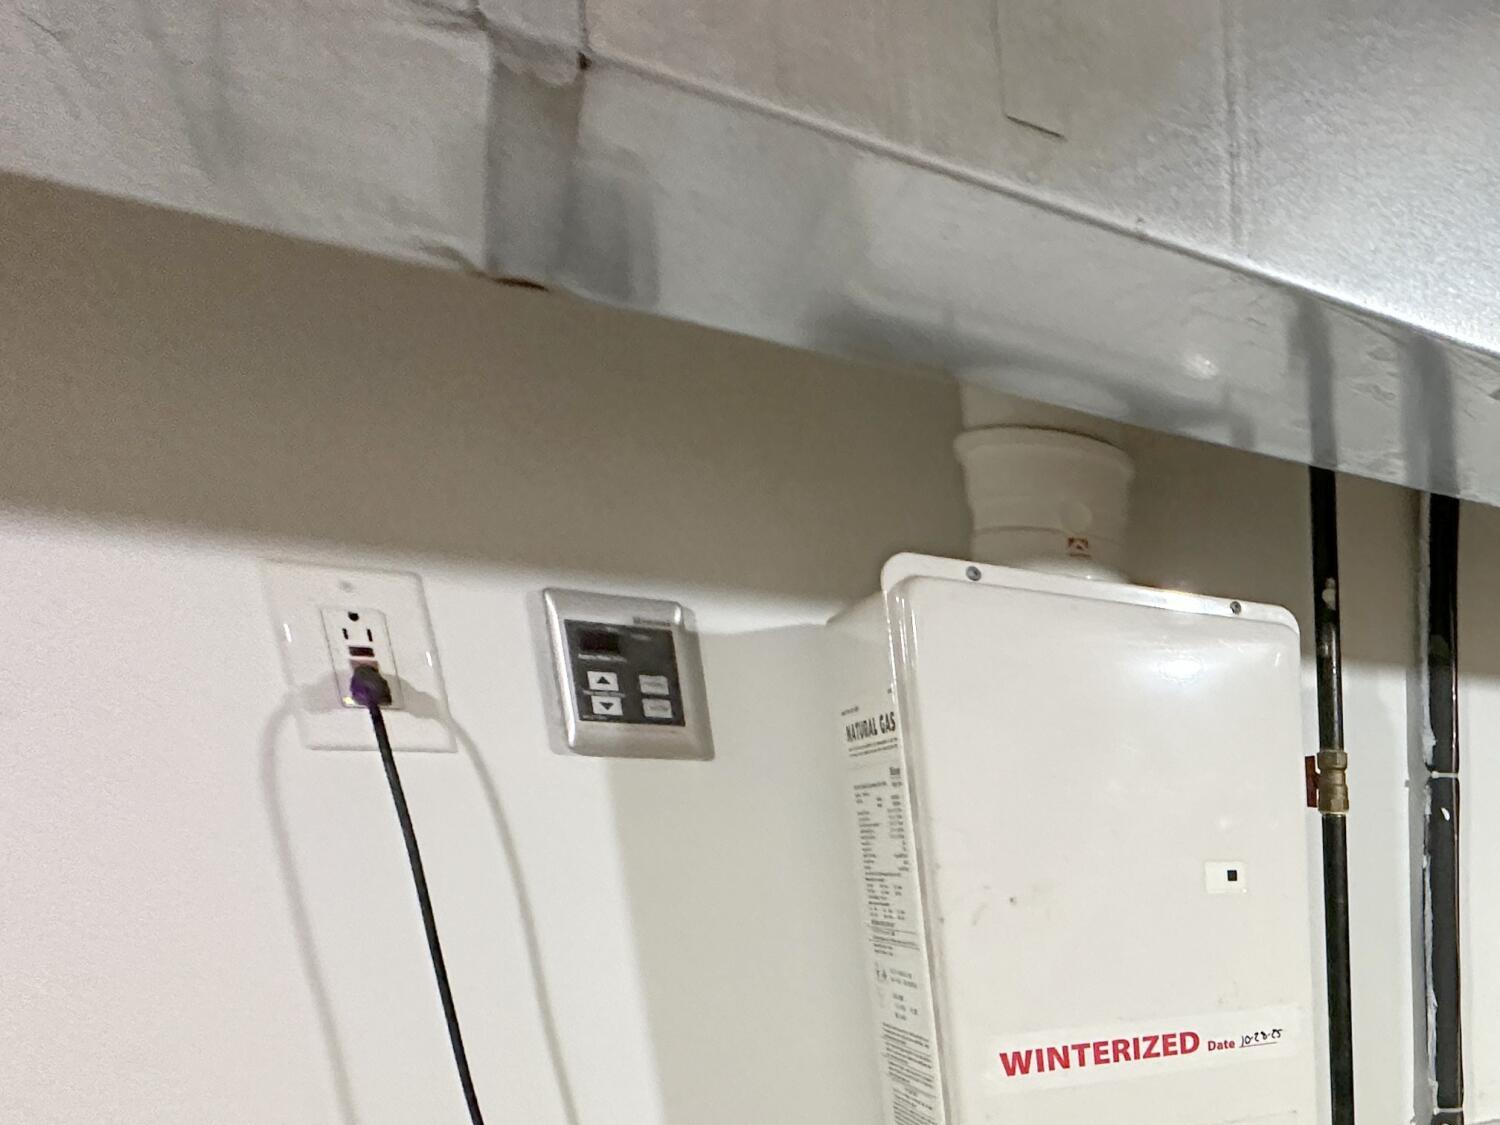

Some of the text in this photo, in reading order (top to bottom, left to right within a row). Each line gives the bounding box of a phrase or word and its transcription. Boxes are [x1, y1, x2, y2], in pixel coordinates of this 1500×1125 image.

[846, 712, 895, 742] NATURAL GAS
[1000, 1031, 1200, 1077] WINTERIZED
[1207, 1039, 1236, 1051] Date
